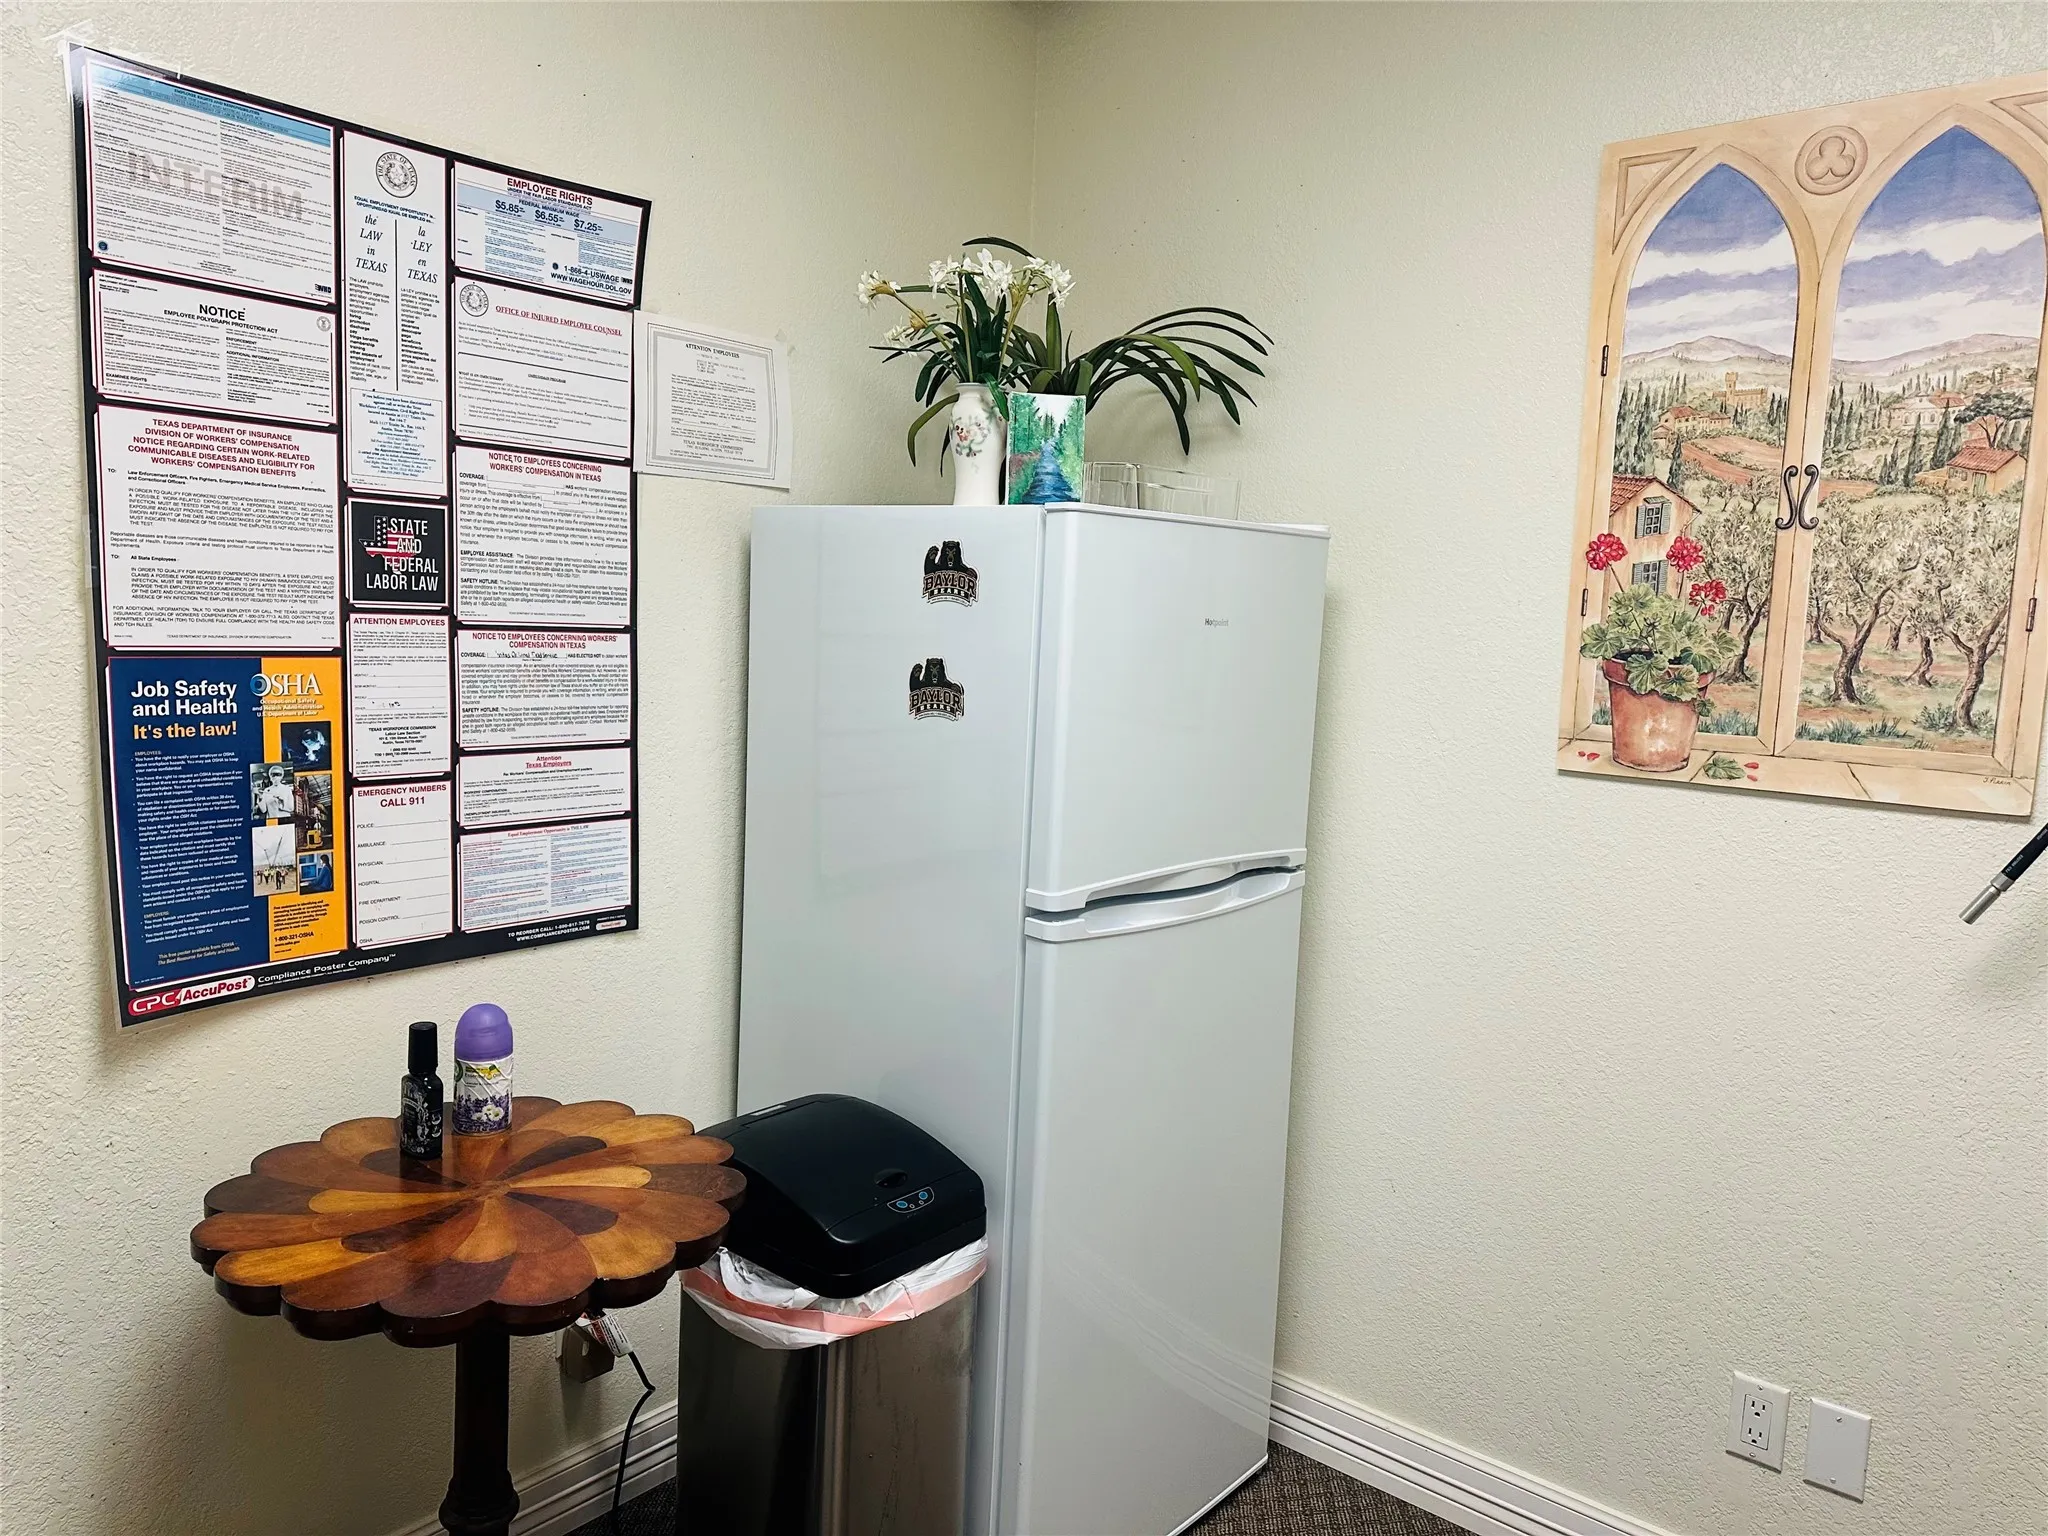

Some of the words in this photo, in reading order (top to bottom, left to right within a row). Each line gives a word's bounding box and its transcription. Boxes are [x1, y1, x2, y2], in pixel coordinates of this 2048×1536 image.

[381, 154, 398, 164] STATE
[400, 156, 407, 165] OF
[408, 166, 416, 187] TEXAS
[129, 150, 302, 220] INTERIM
[507, 178, 557, 197] EMPLOYEE
[559, 190, 593, 206] RIGHTS
[354, 195, 368, 203] EQUAL
[370, 198, 399, 210] EMPLOYMENT
[400, 206, 429, 217] OPPORTUNITY
[495, 199, 520, 213] $5.85
[519, 200, 540, 209] FEDERAL
[542, 205, 564, 214] MINIMUM
[565, 210, 580, 218] WAGE
[365, 214, 377, 225] the
[535, 210, 559, 222] $6.55
[574, 218, 598, 232] $7.25
[360, 228, 383, 241] LAW
[418, 226, 426, 237] la
[367, 245, 375, 256] in
[413, 240, 432, 252] LEY
[355, 257, 388, 273] TEXAS
[407, 268, 438, 284] TEXAS
[164, 310, 195, 320] EMPLOYEE
[197, 315, 230, 326] POLYGRAPH
[231, 321, 266, 332] PROTECTION
[199, 304, 245, 321] NOTICE
[496, 306, 519, 316] OFFICE
[532, 312, 558, 323] INJURED
[560, 318, 593, 330] EMPLOYEE
[593, 325, 622, 336] COUNSEL
[153, 419, 179, 428] TEXAS
[181, 422, 234, 435] DEPARTMENT
[249, 431, 292, 441] INSURANCE
[133, 436, 164, 445] NOTICE
[167, 440, 214, 451] REGARDING
[217, 446, 249, 455] CERTAIN
[251, 450, 310, 461] WORK-RELATED
[145, 428, 181, 437] DIVISION
[196, 434, 238, 444] WORKERS'
[240, 439, 300, 451] COMPENSATION
[128, 445, 196, 458] COMMUNICABLE
[199, 453, 237, 462] DISEASES
[257, 459, 298, 468] ELIGIBILITY
[489, 452, 512, 461] NOTICE
[524, 456, 561, 468] EMPLOYEES
[562, 461, 602, 472] CONCERNING
[151, 457, 195, 467] WORKERS'
[197, 462, 259, 473] COMPENSATION
[261, 468, 296, 477] BENEFITS
[490, 463, 524, 473] WORKERS'
[525, 467, 574, 478] COMPENSATION
[582, 474, 601, 482] TEXAS
[390, 518, 428, 536] STATE
[397, 538, 422, 553] AND
[384, 556, 438, 573] FEDERAL
[366, 573, 407, 590] LABOR
[412, 576, 438, 591] LAW
[925, 572, 976, 597] BAYLOR
[934, 588, 964, 596] BEARS
[399, 618, 445, 626] EMPLOYEES
[131, 681, 169, 697] Job
[175, 680, 237, 698] Safety
[250, 673, 322, 696] OSHA
[132, 700, 169, 716] and
[175, 698, 237, 715] Health
[911, 689, 962, 711] BAYLOR
[134, 724, 162, 740] It's
[166, 723, 196, 738] the
[200, 721, 236, 736] law!
[358, 787, 407, 797] EMERGENCY
[409, 784, 446, 793] NUMBERS
[380, 798, 406, 807] CALL
[409, 797, 425, 805] 911
[274, 931, 314, 942] 1-800-321-OSHA
[516, 928, 539, 936] REORDER
[258, 968, 311, 983] Compliance
[314, 963, 345, 972] Poster
[132, 992, 176, 1012] CPC
